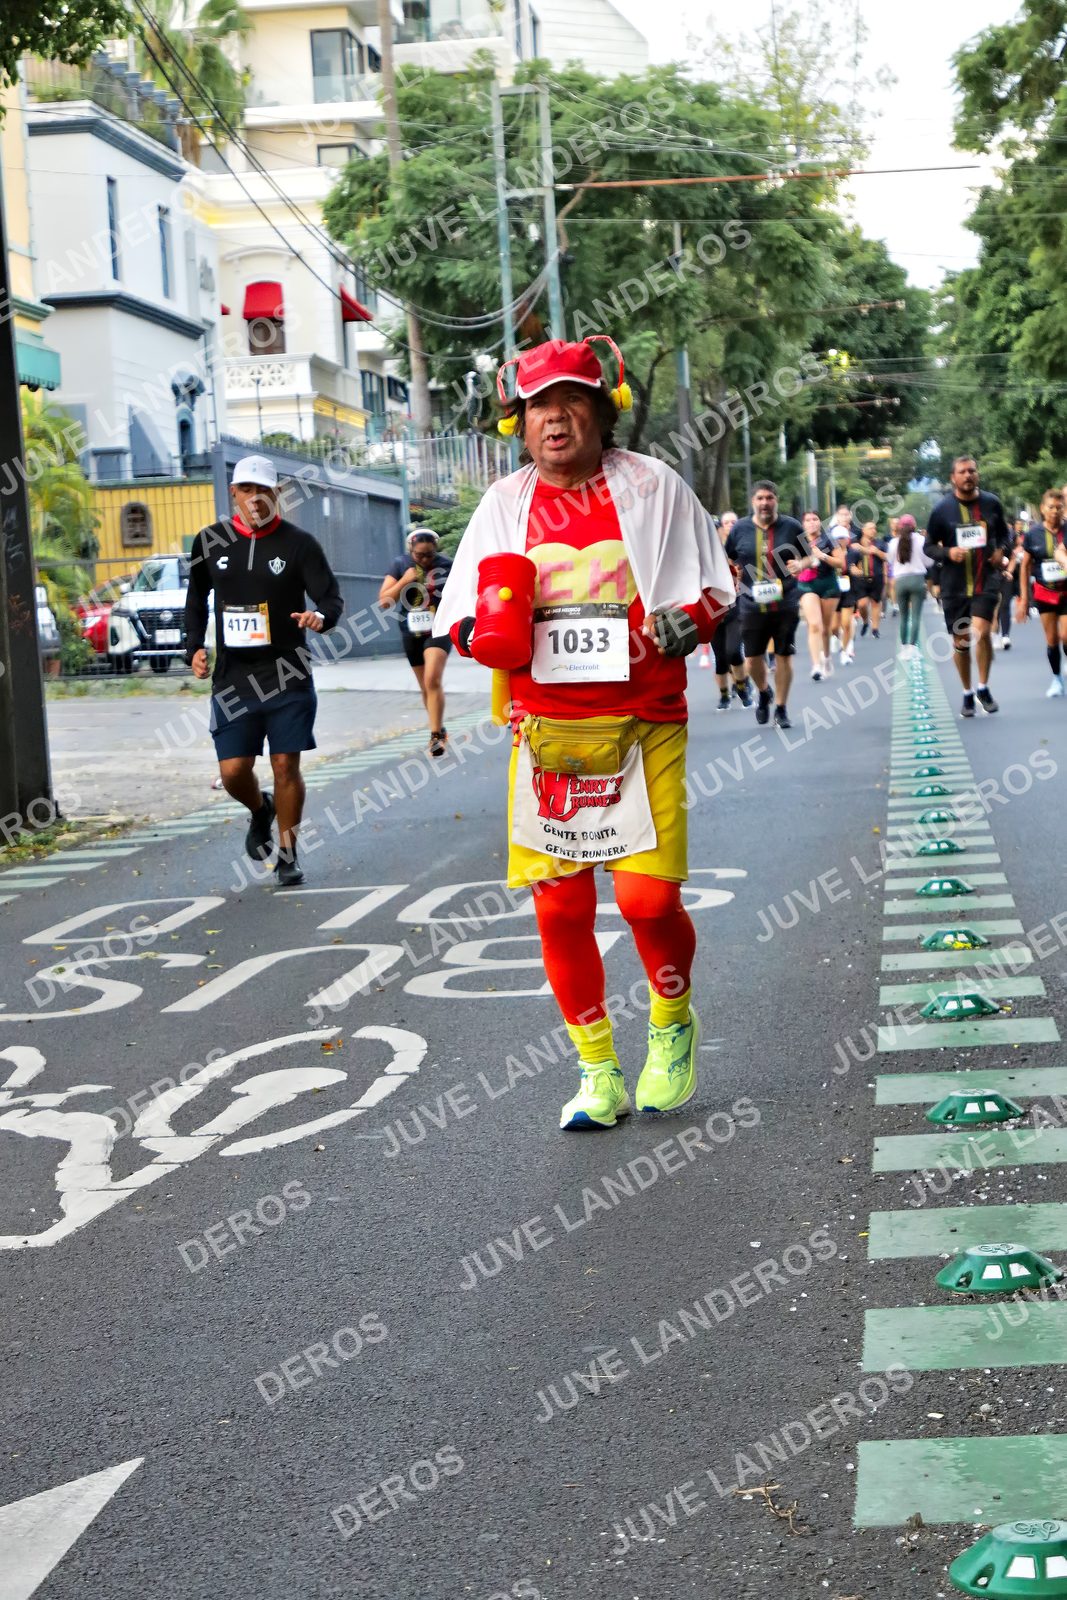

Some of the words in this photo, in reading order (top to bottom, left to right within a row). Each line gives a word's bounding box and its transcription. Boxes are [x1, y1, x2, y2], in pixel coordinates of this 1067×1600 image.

[228, 618, 258, 631] 4171
[548, 627, 611, 654] 1033
[545, 843, 577, 858] GENTE
